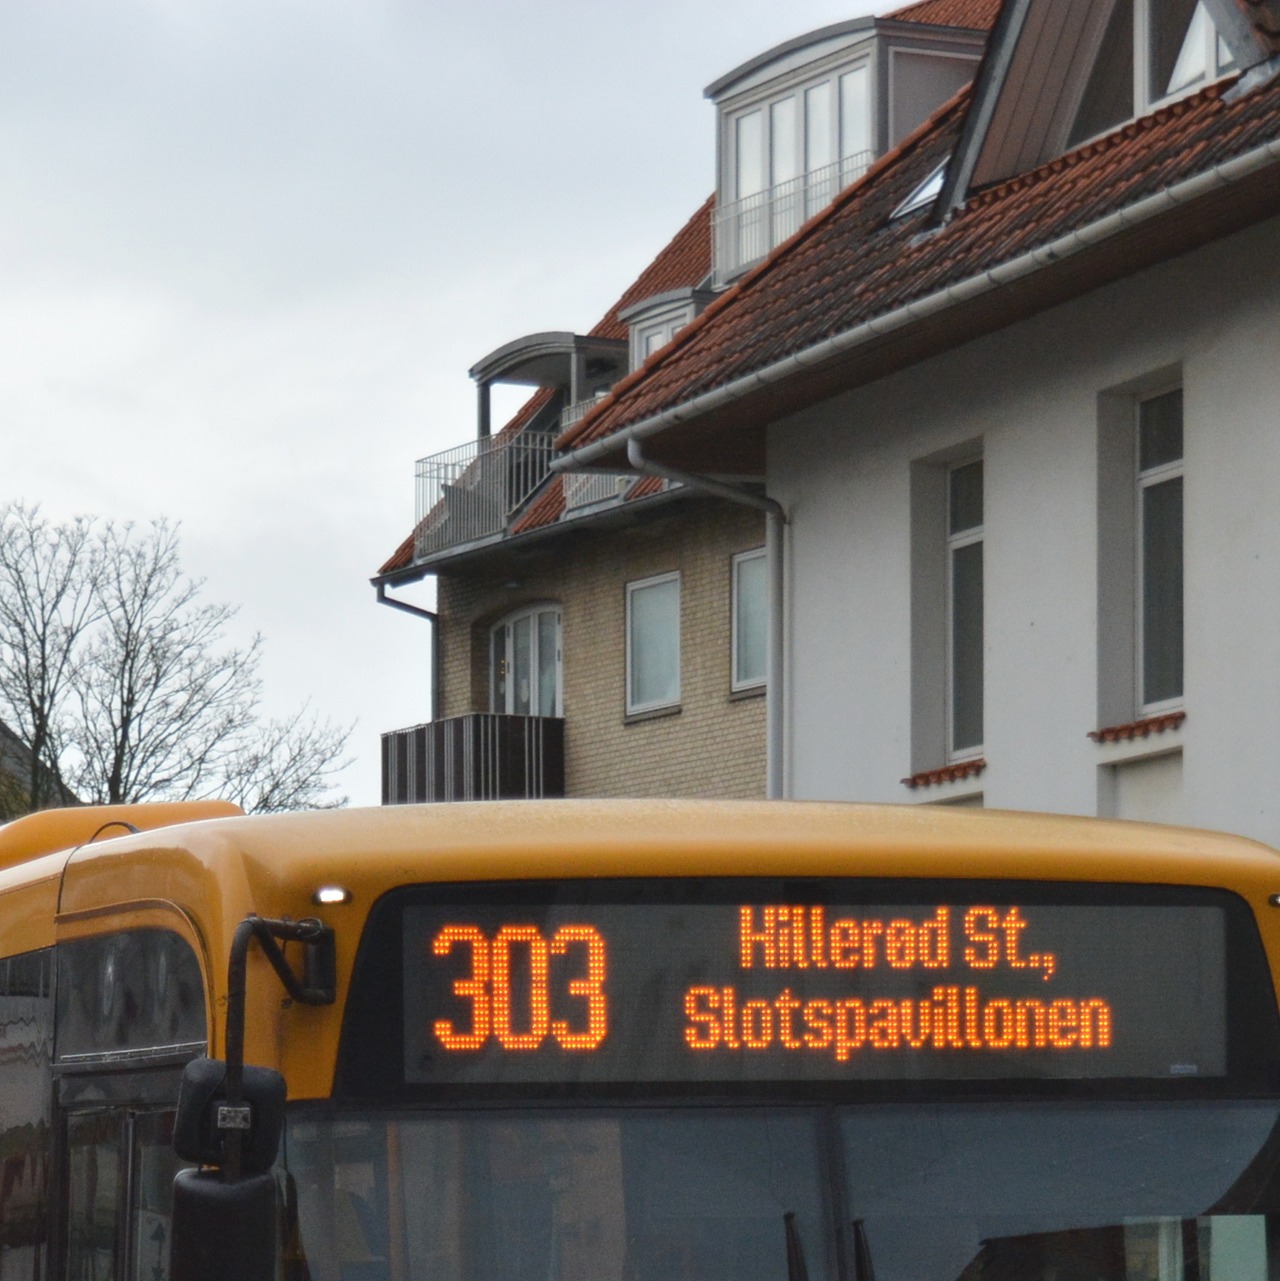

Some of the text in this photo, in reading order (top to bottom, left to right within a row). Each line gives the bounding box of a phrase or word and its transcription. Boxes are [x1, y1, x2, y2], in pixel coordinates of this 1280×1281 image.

[738, 905, 1056, 980] Hillerød St.,
[432, 924, 608, 1051] 303
[683, 985, 1112, 1062] Slotspavillonen
